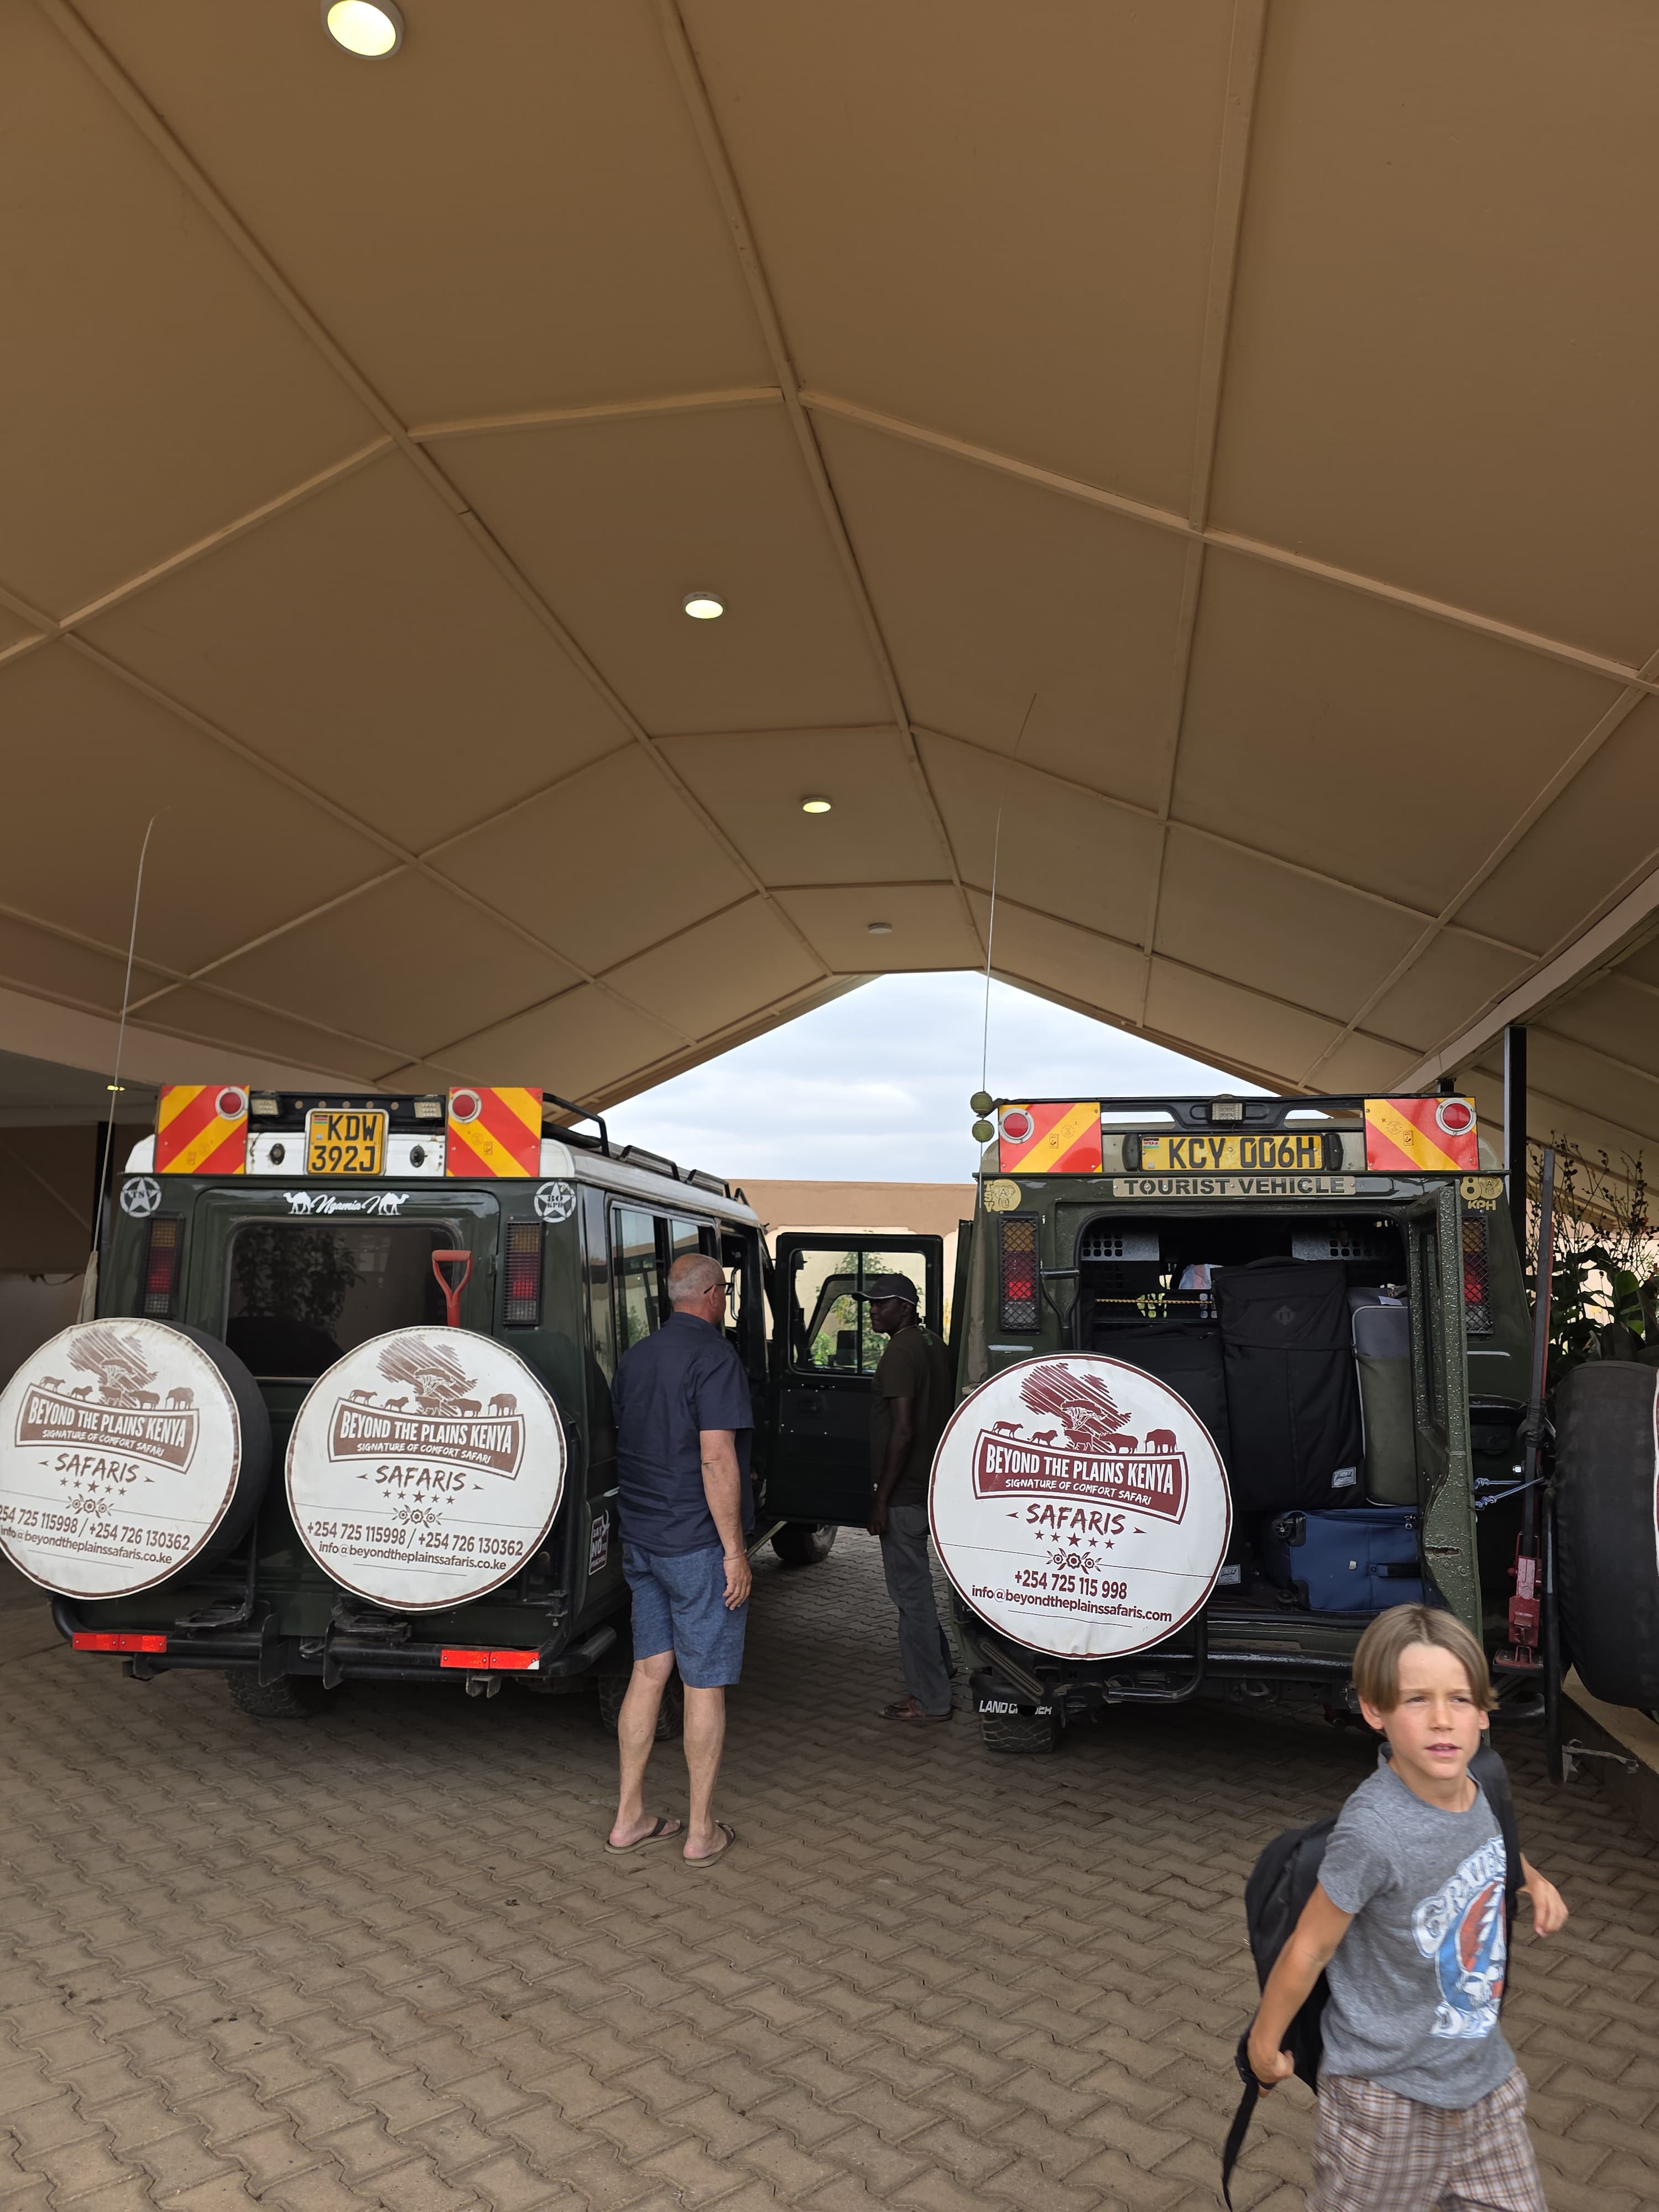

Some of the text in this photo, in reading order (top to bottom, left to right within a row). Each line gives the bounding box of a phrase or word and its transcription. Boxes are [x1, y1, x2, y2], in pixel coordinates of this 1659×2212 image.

[327, 1115, 377, 1141] KDW
[311, 1145, 376, 1172] 392J
[1168, 1136, 1314, 1168] KCY 006H
[1124, 1177, 1344, 1195] TOURIST VEHICLE
[1468, 1200, 1496, 1210] KPH
[28, 1396, 187, 1448] BEYOND THE PLAINS KENYA
[340, 1411, 512, 1454] BEYOND THE PLAINS KENYA
[42, 1429, 86, 1441] SIGNATURE
[87, 1433, 98, 1442] OF
[136, 1442, 165, 1457] SAFARI
[357, 1442, 492, 1464] SIGNATURE OF COMFORT SAFARI
[54, 1453, 140, 1483] SAFARIS
[375, 1465, 467, 1492] SAFARIS
[985, 1444, 1173, 1495] BEYOND THE PLAINS KENYA
[1005, 1479, 1152, 1505] SIGNATURE OF COMFORT SAFARI
[17, 1509, 39, 1526] 725
[41, 1512, 78, 1534] 115998
[90, 1522, 117, 1541] +254
[120, 1526, 143, 1545] 726
[145, 1530, 190, 1551] 130362
[1026, 1503, 1126, 1535] SAFARIS
[1, 1525, 173, 1564] info@beyondtheplainssafaris.co.ke
[307, 1521, 337, 1538] +254
[340, 1523, 362, 1541] 725
[366, 1526, 406, 1545] 115998
[418, 1532, 450, 1550] +254
[451, 1535, 475, 1552] 726
[478, 1537, 524, 1556] 130362
[591, 1538, 602, 1558] NO
[319, 1541, 507, 1571] info@beyondtheplainssafaris.co.ke
[1015, 1569, 1128, 1600] +254 725 115 998
[972, 1585, 1172, 1622] info@beyondtheplainssafaris.com
[979, 1700, 1008, 1714] LAND
